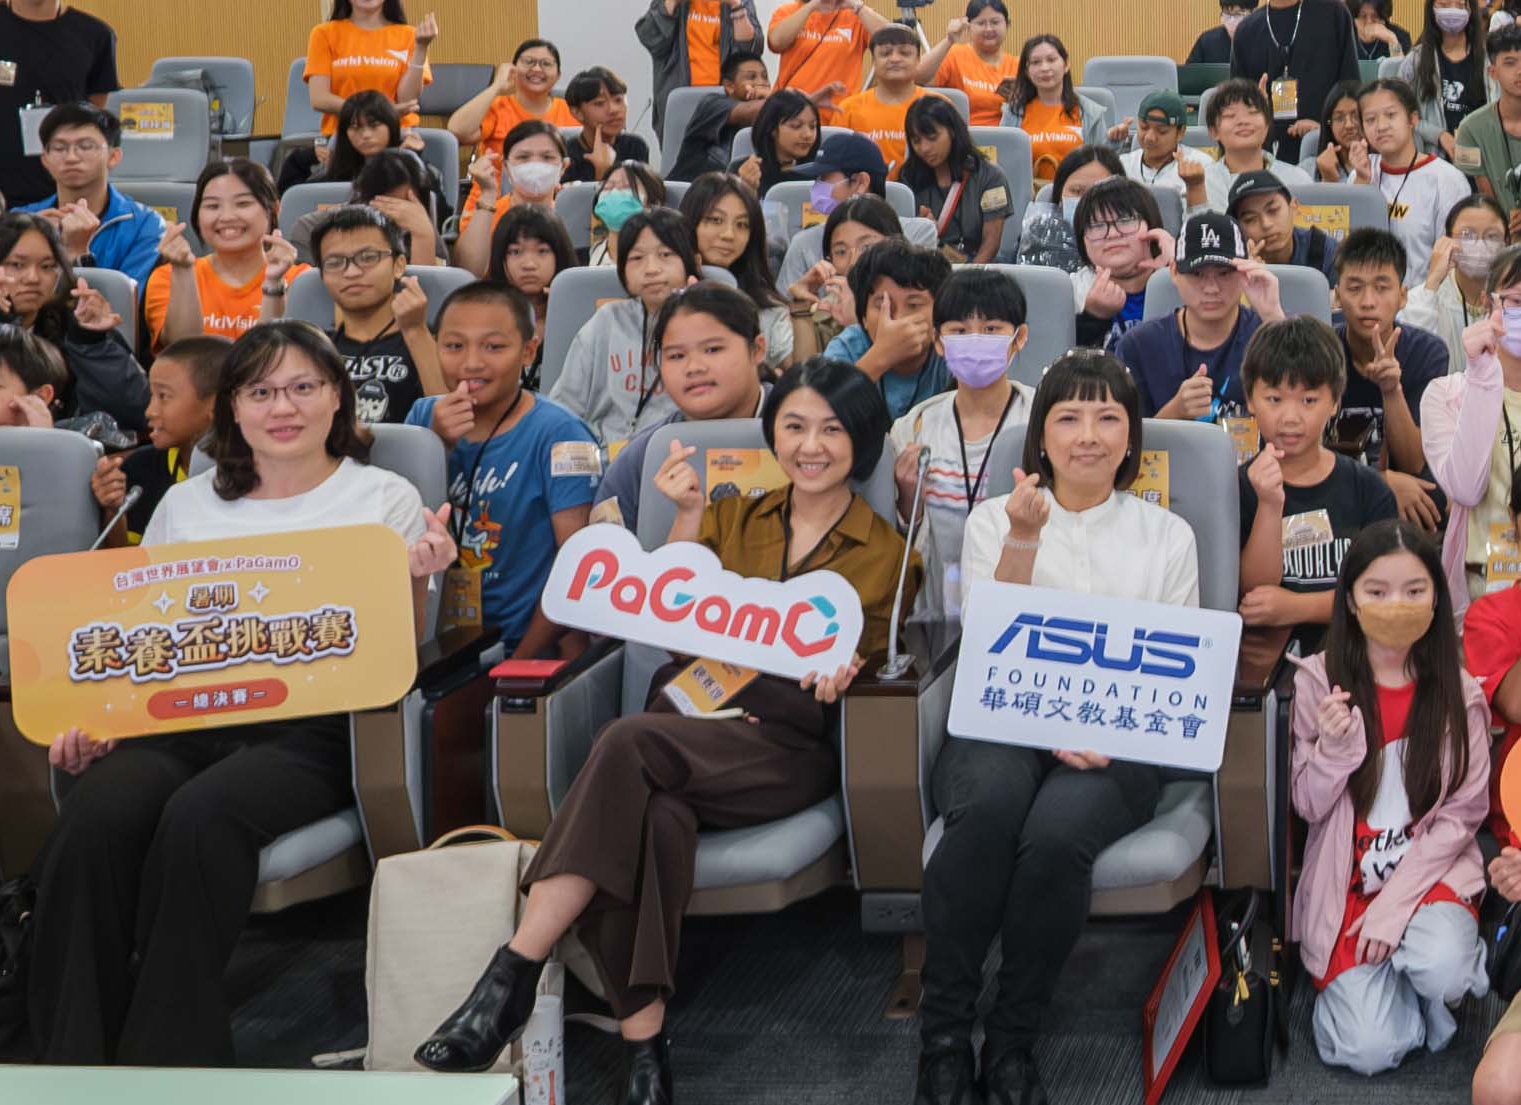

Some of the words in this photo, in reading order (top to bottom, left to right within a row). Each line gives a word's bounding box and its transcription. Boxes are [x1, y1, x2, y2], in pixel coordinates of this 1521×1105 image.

[1200, 223, 1220, 249] LA
[202, 313, 227, 329] rld
[116, 557, 219, 589] 台灣世界展望會
[236, 556, 300, 571] PaGamO
[190, 585, 236, 609] 暑期
[566, 548, 840, 658] PaGamO
[76, 610, 353, 675] 素養盃挑戰賽
[987, 611, 1201, 679] ASUS
[192, 687, 248, 711] 總決賽
[986, 666, 1209, 711] FOUNDATION
[978, 685, 1208, 739] 華碩文教基金會
